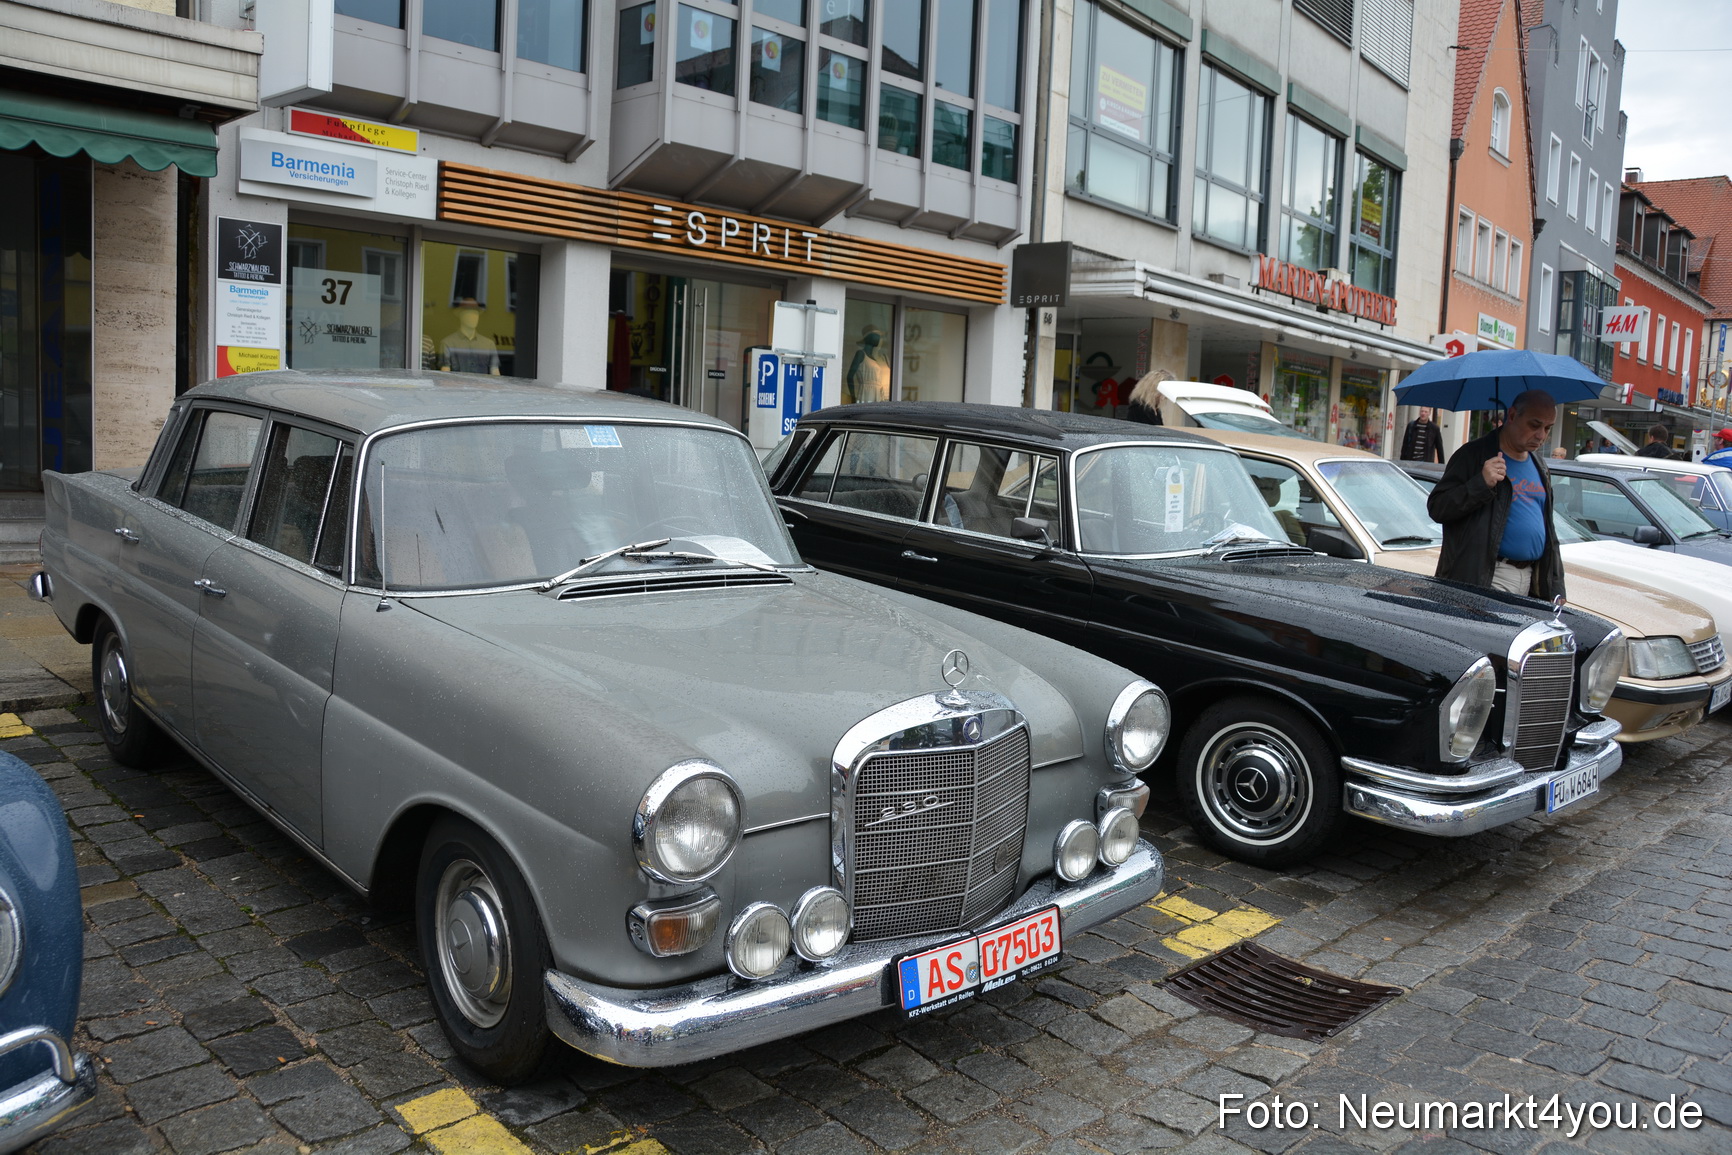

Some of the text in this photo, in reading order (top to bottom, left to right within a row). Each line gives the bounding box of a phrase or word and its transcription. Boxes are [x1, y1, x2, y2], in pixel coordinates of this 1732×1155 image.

[322, 130, 357, 142] Michael
[326, 118, 386, 136] Fußpflege
[271, 151, 355, 179] Barmenia
[385, 167, 428, 181] Service-Center
[289, 170, 349, 187] Versicherungen
[385, 177, 430, 191] Christoph Riedl
[385, 187, 417, 199] & Kollegen
[652, 204, 818, 262] ESPRIT
[229, 285, 269, 296] Barmenia
[321, 278, 353, 305] 37
[1019, 294, 1060, 304] ESPRIT
[1259, 253, 1398, 327] MARIEN-APOTHEKE
[1605, 314, 1639, 334] H&M
[761, 361, 775, 386] P
[789, 364, 818, 378] HIR
[1553, 780, 1565, 807] FÜ
[881, 795, 939, 820] 230
[927, 916, 1055, 998] AS 07503
[908, 989, 915, 1001] D
[908, 990, 975, 1018] KFZ-Werkstatt und Reifen
